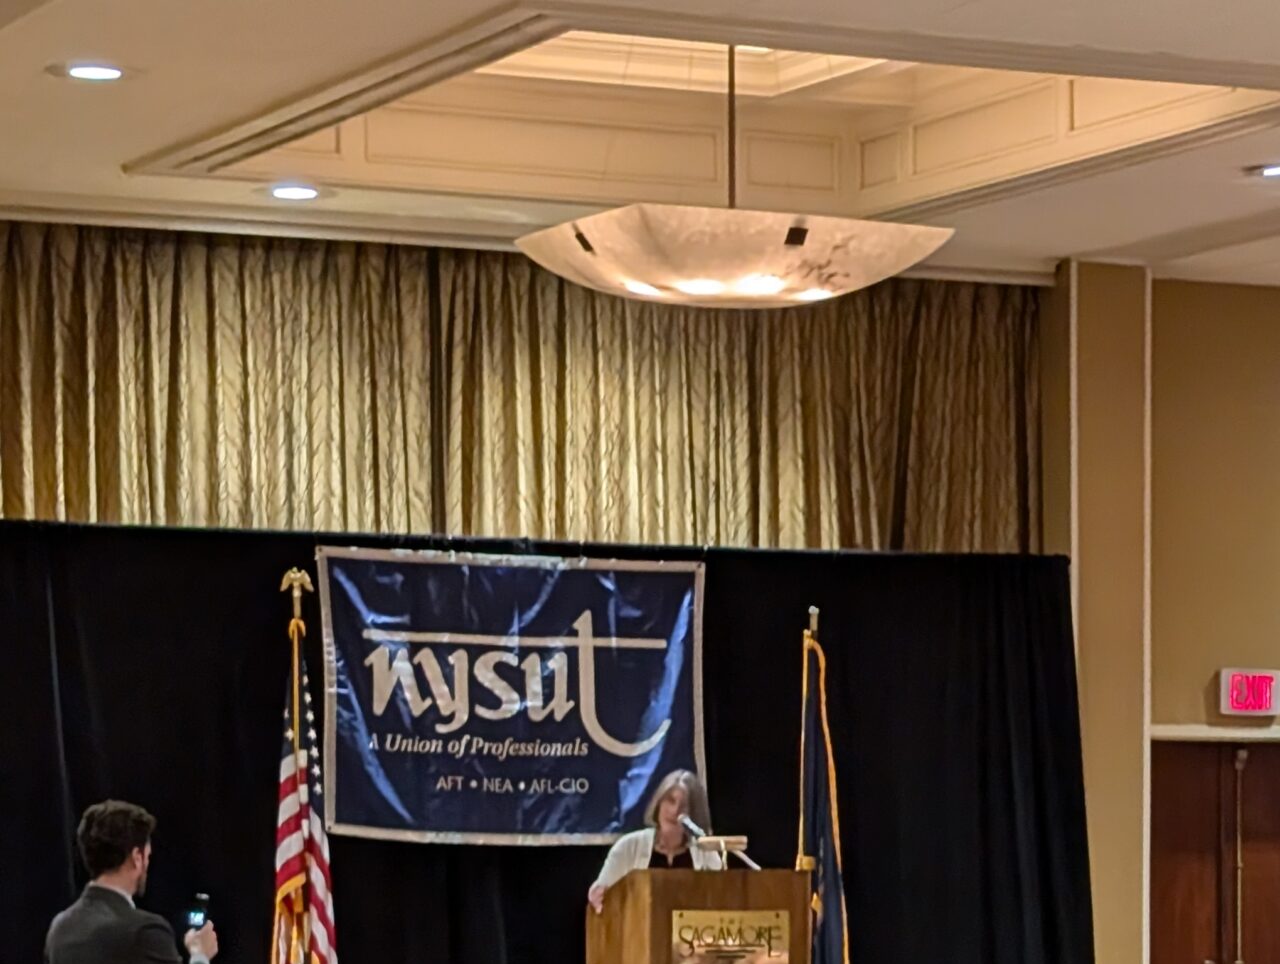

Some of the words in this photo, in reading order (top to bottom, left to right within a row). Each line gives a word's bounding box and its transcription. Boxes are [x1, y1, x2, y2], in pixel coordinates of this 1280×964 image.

[362, 609, 671, 757] nysut
[1231, 674, 1274, 710] EXIT
[368, 732, 379, 750] A
[385, 734, 443, 753] Union
[447, 734, 470, 759] of
[470, 737, 589, 761] Professionals
[436, 776, 464, 791] AFT
[483, 778, 513, 793] NEA
[529, 778, 590, 794] AFL-CIO
[679, 924, 783, 958] SAGAMORE
